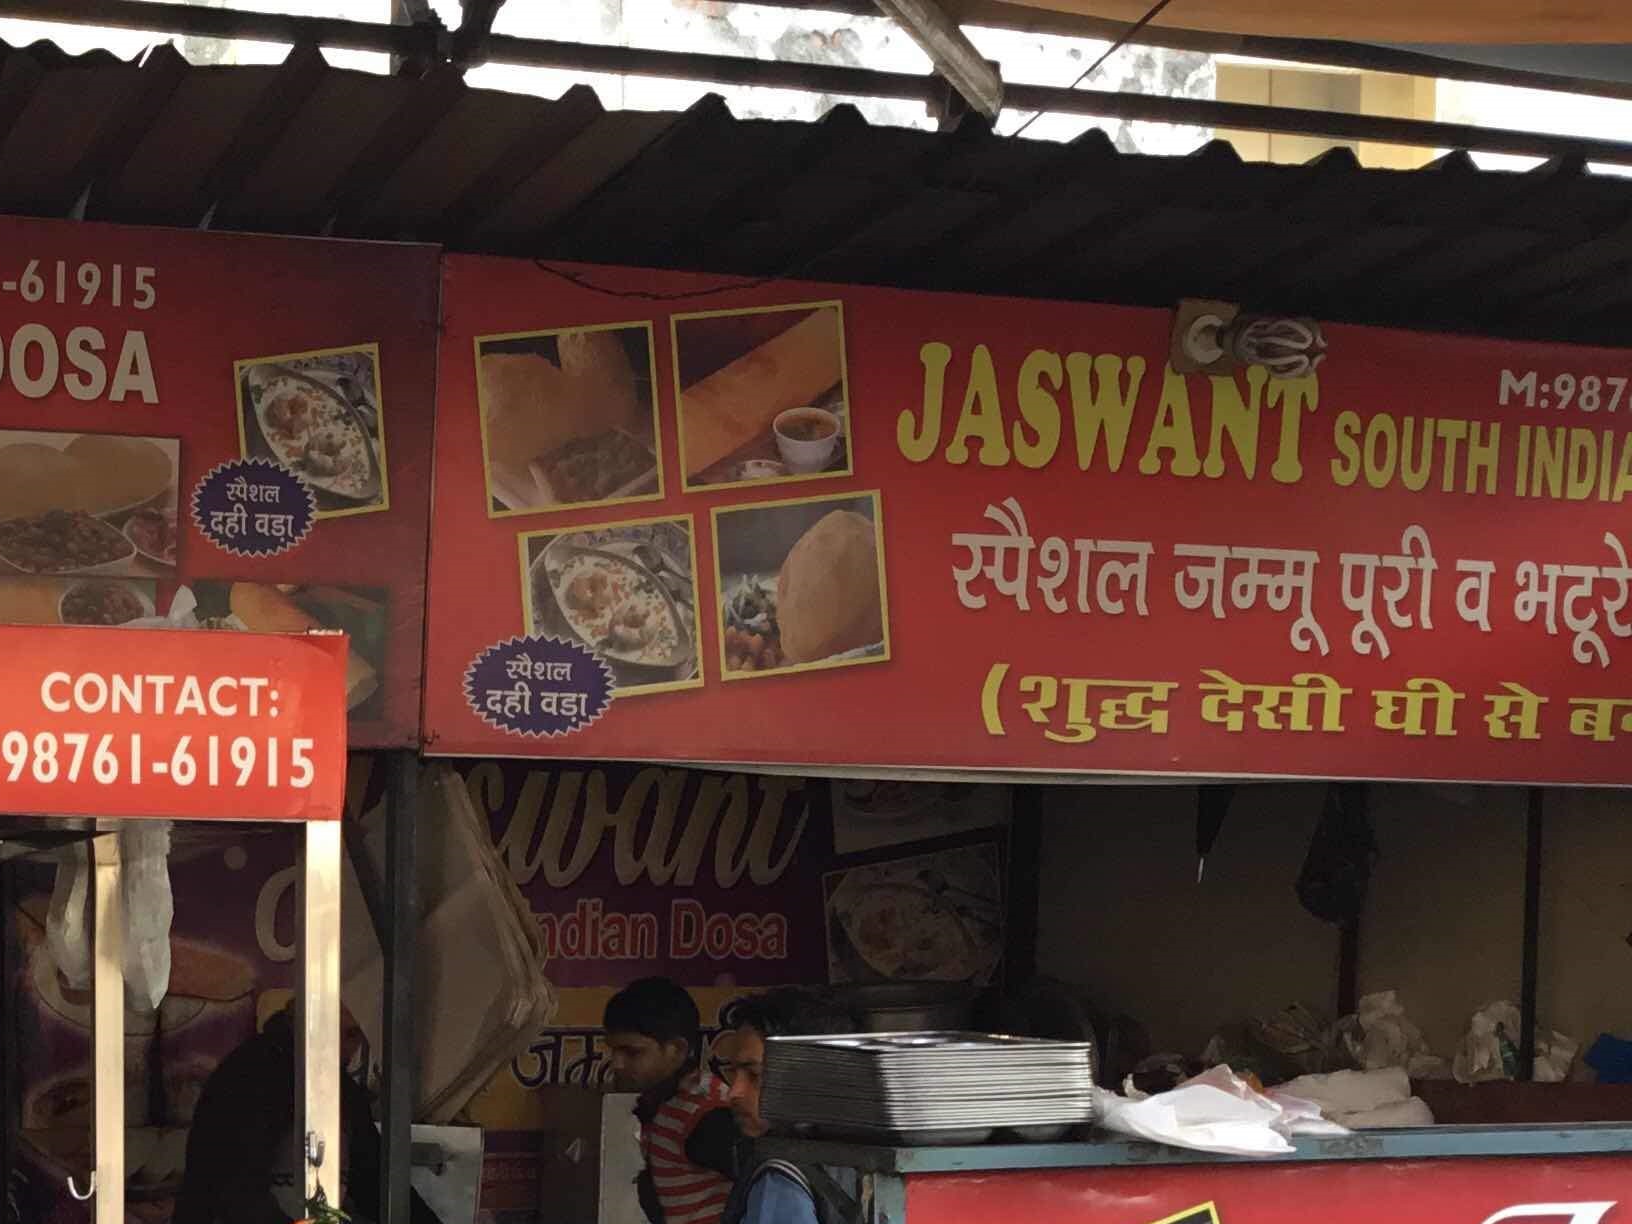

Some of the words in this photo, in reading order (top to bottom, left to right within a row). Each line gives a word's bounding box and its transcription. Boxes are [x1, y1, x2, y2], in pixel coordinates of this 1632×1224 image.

[1498, 369, 1632, 413] M:987
[896, 342, 1319, 483] JASWANT
[1330, 410, 1498, 496] SOUTH
[226, 477, 281, 505] स्पैशल
[210, 504, 250, 537] दही
[951, 497, 1155, 616] स्पैशल
[1174, 542, 1329, 656] जम्मू
[1340, 525, 1437, 660] पूरी
[1456, 559, 1495, 632] व
[1514, 532, 1632, 668] भटूरे
[41, 672, 280, 717] CONTACT:
[505, 656, 572, 683] स्पैशल
[486, 684, 532, 720] दही
[1200, 669, 1352, 733] देसी
[1371, 678, 1465, 736] घी
[1484, 681, 1549, 740] से
[1569, 697, 1632, 742] ब
[2, 730, 315, 790] 98761-61915
[463, 762, 810, 890] want
[538, 898, 659, 960] ndian
[669, 898, 787, 961] Dosa
